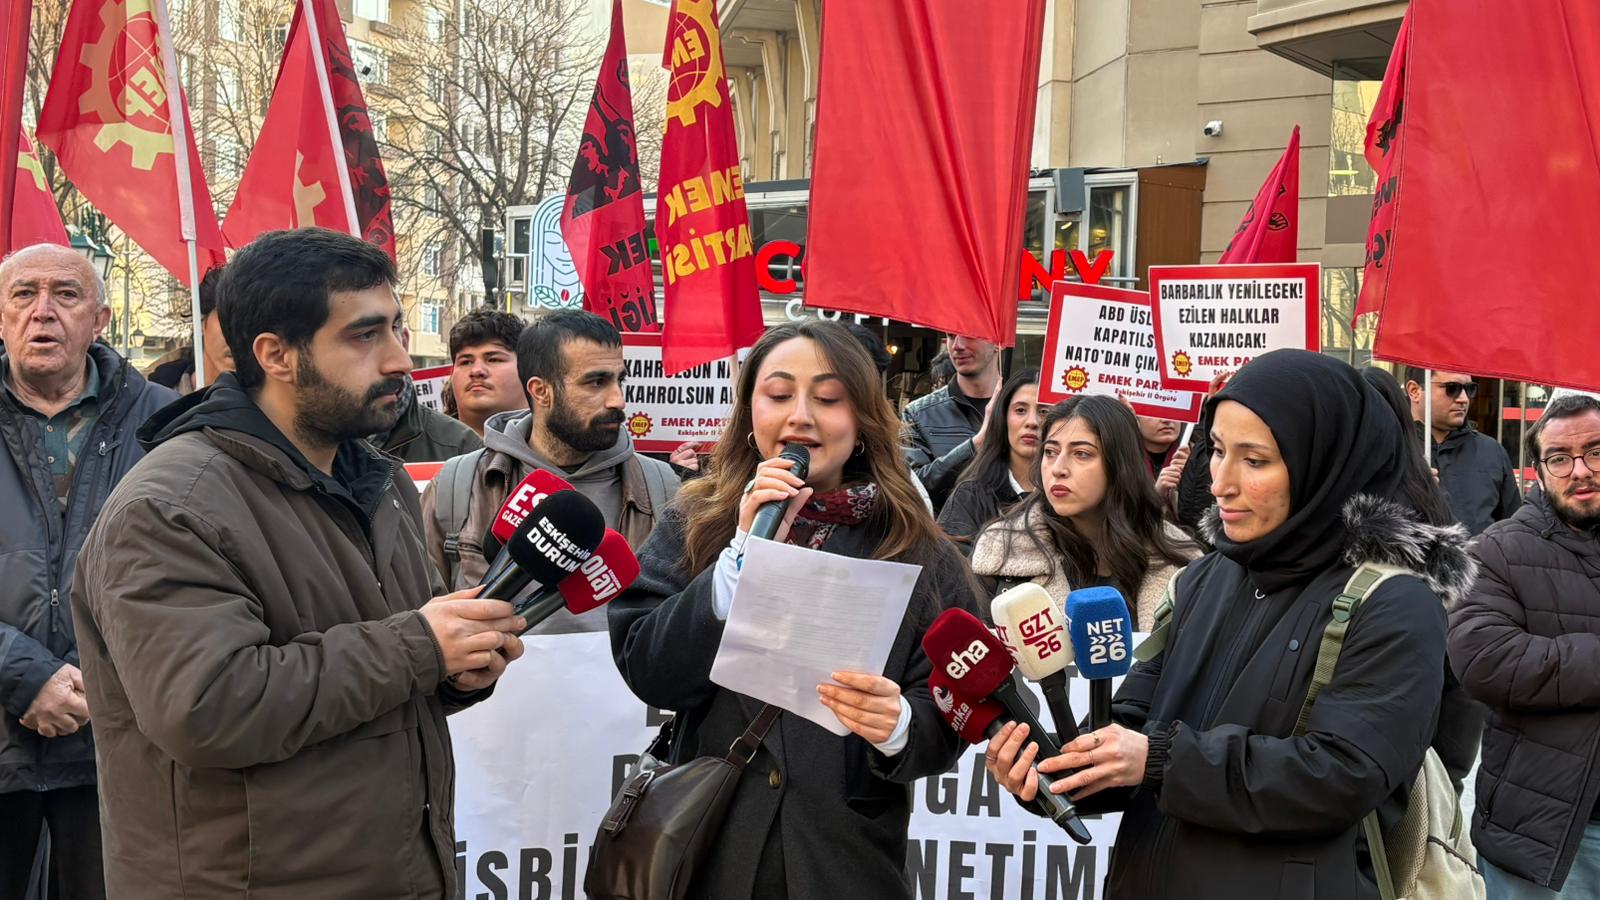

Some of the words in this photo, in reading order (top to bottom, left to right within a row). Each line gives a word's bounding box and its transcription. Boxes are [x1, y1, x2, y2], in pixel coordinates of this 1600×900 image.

[1161, 284, 1223, 300] BARBARLIK
[1228, 280, 1303, 299] YENİLECEK!
[1099, 305, 1125, 322] ABD
[1179, 305, 1216, 324] EZİLEN
[1221, 308, 1280, 324] HALKLAR
[1094, 327, 1156, 349] KAPATILS
[1189, 332, 1266, 349] KAZANACAK!
[1198, 356, 1229, 366] EMEK
[1234, 356, 1254, 367] PA
[1098, 373, 1132, 387] EMEK
[625, 385, 715, 405] KAHROLSUN
[661, 418, 693, 427] EMEK
[538, 516, 591, 561] ESKİŞEHİR
[526, 527, 581, 573] DURUM
[1018, 607, 1054, 638] GZT
[1086, 618, 1124, 635] NET
[1035, 634, 1062, 659] 26
[1090, 641, 1127, 665] 26
[946, 639, 990, 680] eha
[455, 833, 593, 900] İSBİ
[908, 830, 1113, 900] NETİM
